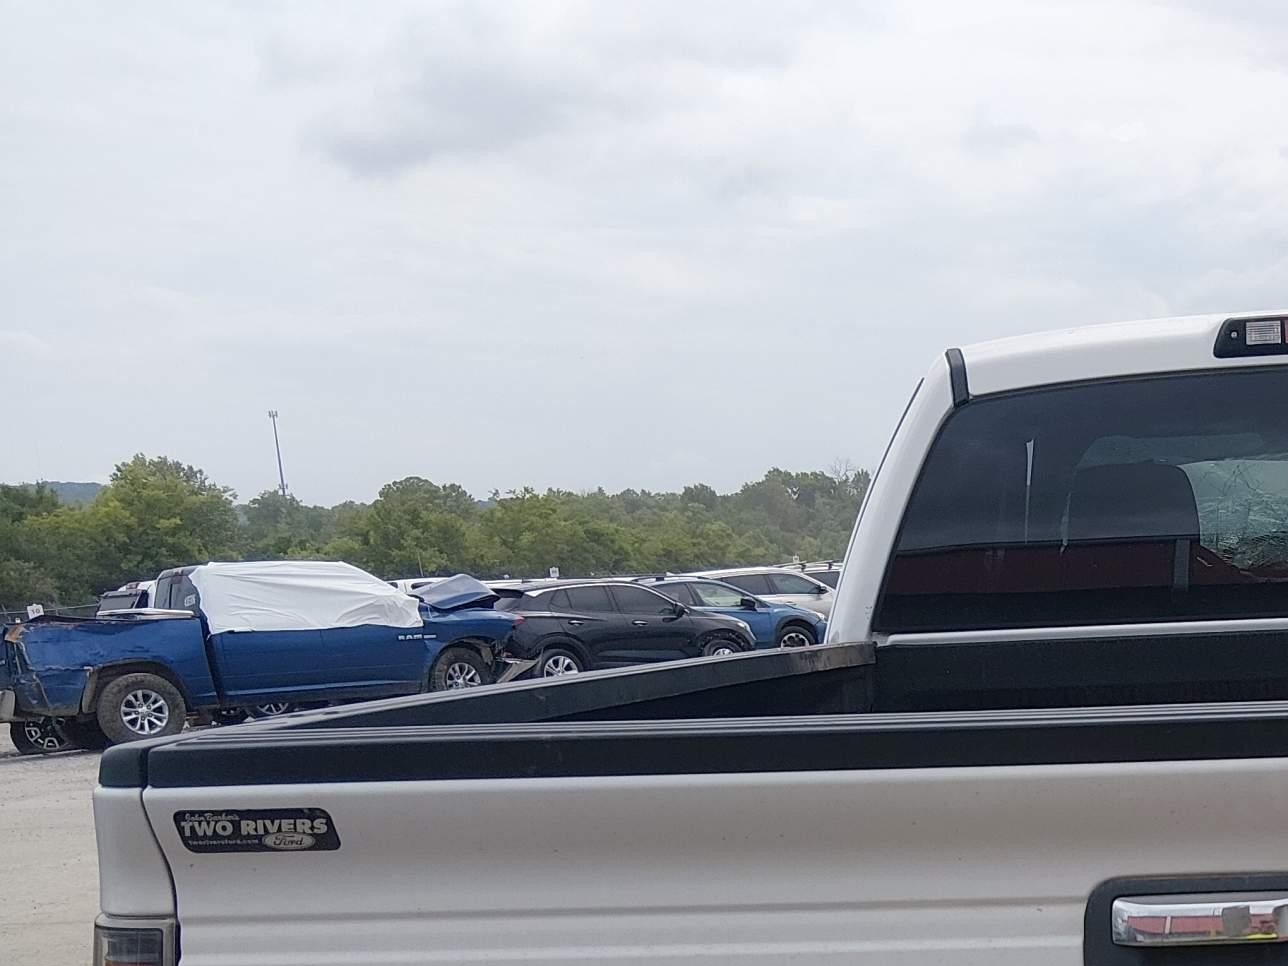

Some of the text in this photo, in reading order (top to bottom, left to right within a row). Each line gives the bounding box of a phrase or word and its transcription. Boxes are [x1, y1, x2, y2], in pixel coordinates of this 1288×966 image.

[180, 818, 328, 837] TWO RIVERS
[273, 835, 305, 847] Ford
